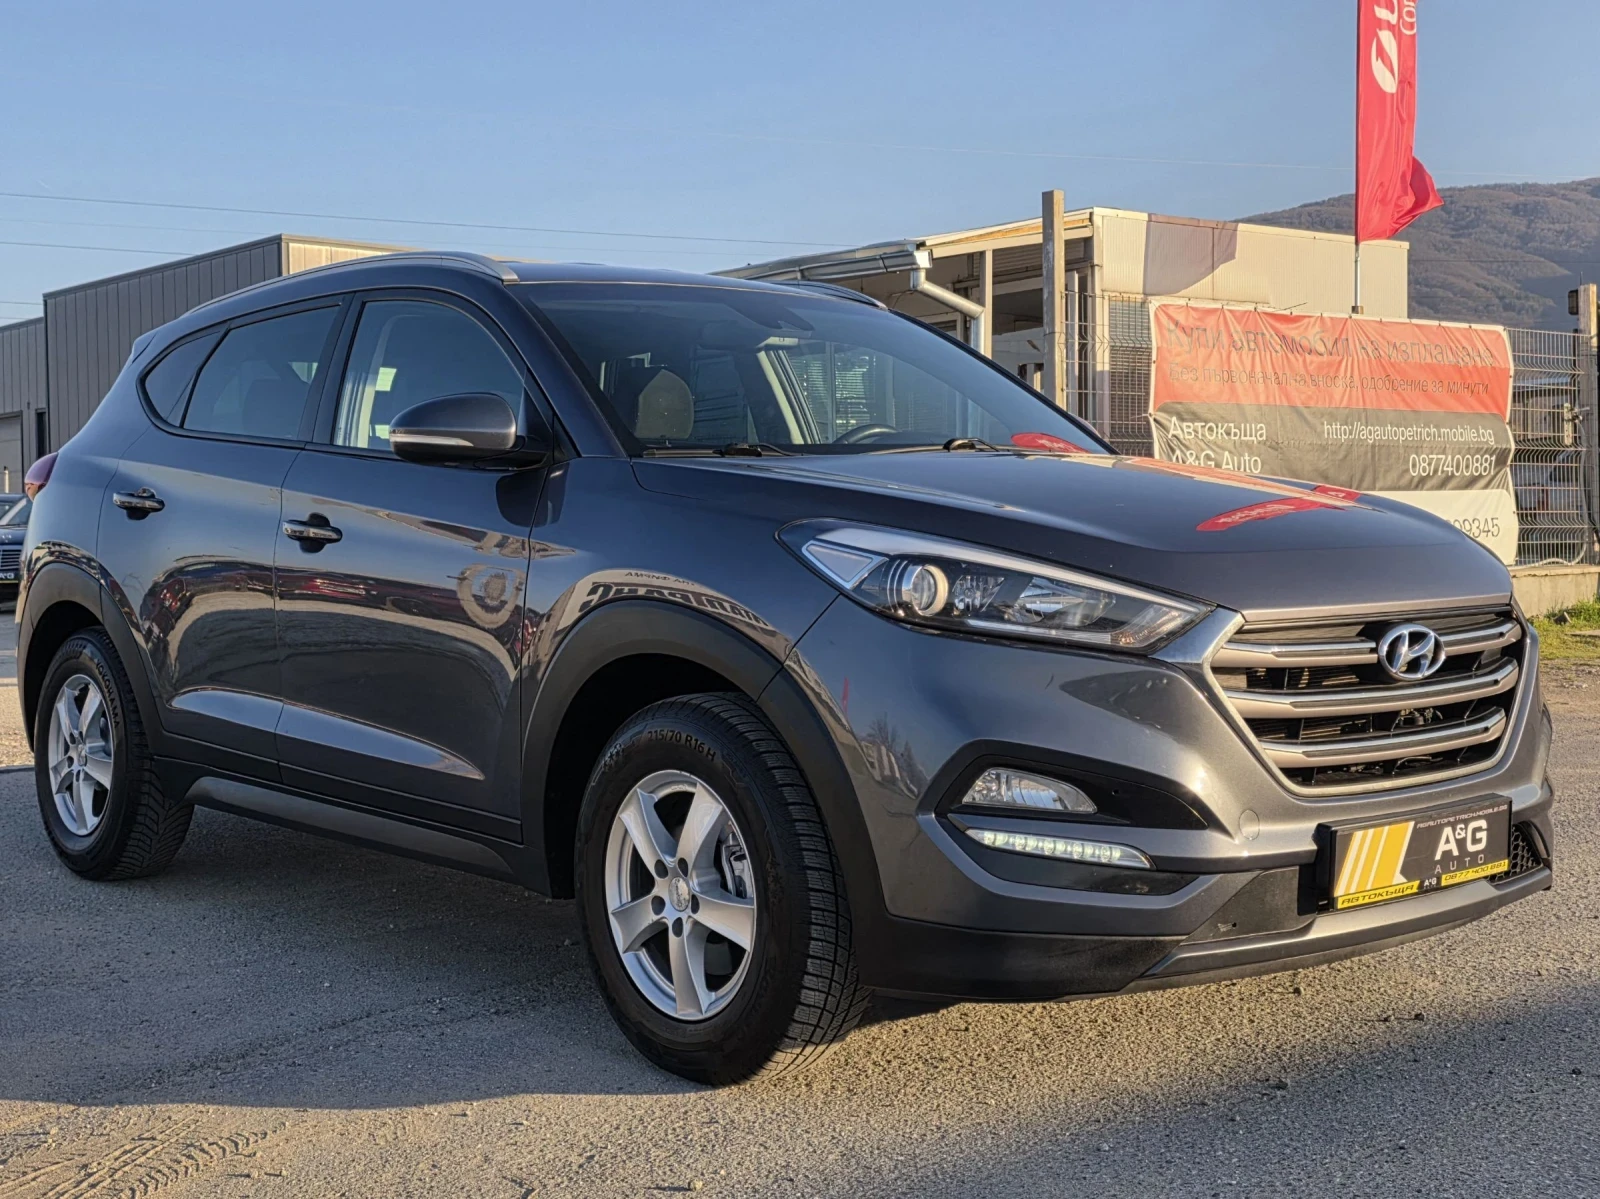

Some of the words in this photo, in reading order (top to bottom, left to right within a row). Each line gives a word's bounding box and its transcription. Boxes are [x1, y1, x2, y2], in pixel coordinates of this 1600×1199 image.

[1167, 320, 1225, 354] Купи
[1231, 328, 1352, 358] автомобил
[1168, 362, 1198, 382] Без
[1361, 374, 1429, 396] одобрение
[1431, 380, 1444, 394] за
[1446, 380, 1489, 397] минути
[1168, 416, 1267, 444] Автокъща
[1324, 421, 1495, 445] http://agautopetrich.mobile.bg
[1221, 451, 1263, 474] Auto
[1409, 454, 1496, 477] 0877400881
[96, 658, 120, 728] YOKOHAMA
[647, 728, 682, 743] 215/70
[684, 734, 706, 754] R16
[1434, 819, 1488, 861] A&G
[1434, 854, 1486, 875] AUTO
[1444, 870, 1470, 881] 0877
[1471, 865, 1489, 875] 400
[1341, 884, 1415, 906] АВТОКЪЩА
